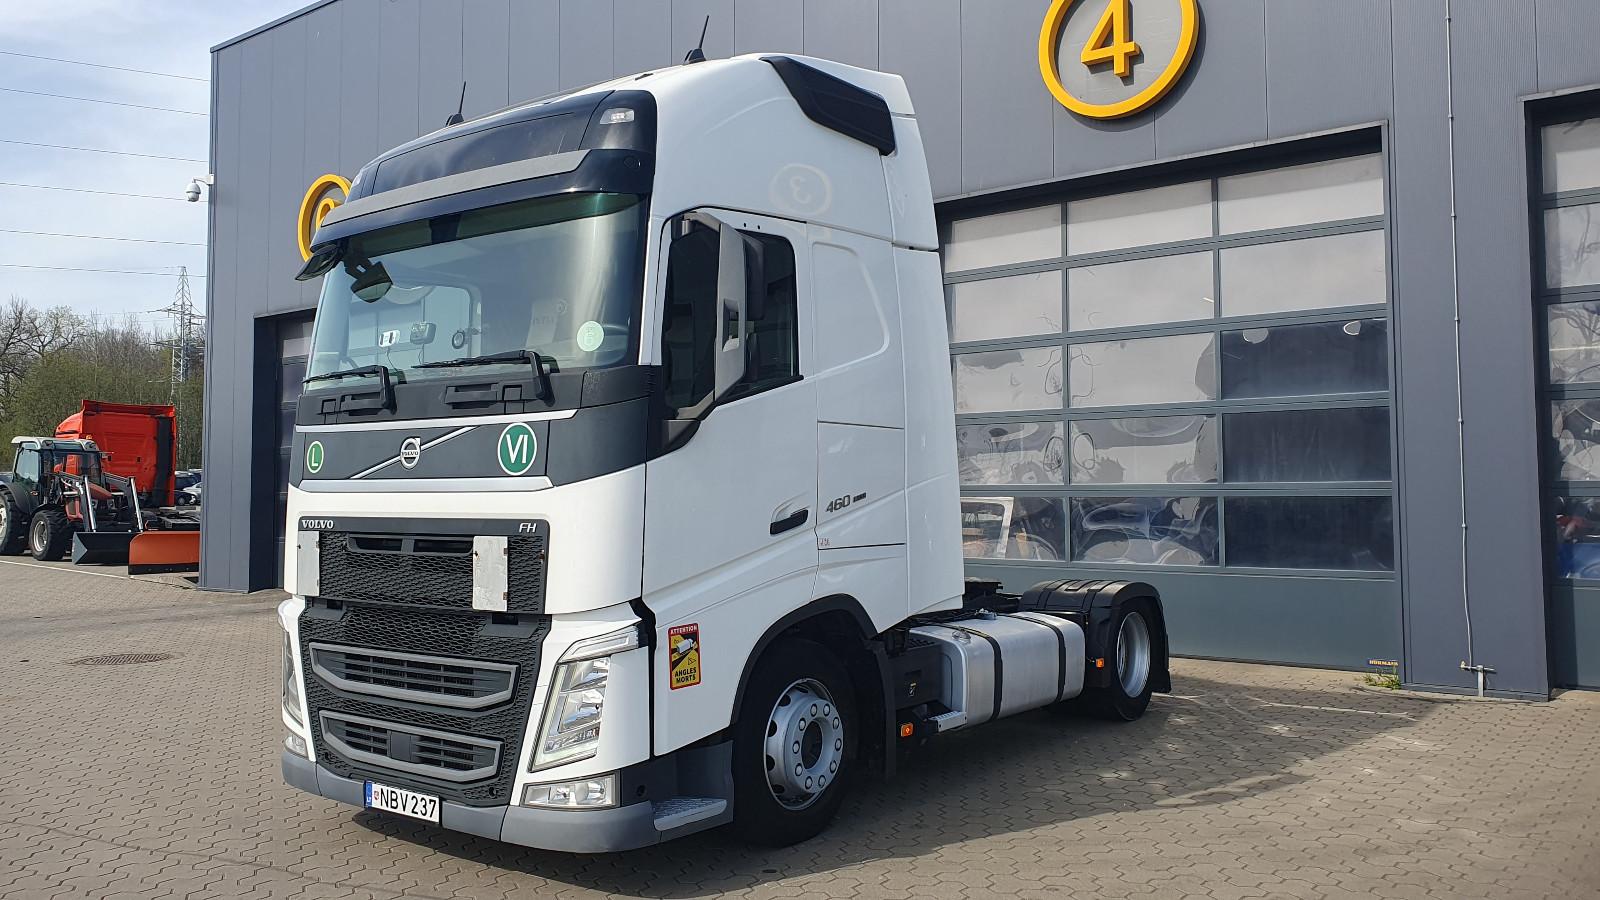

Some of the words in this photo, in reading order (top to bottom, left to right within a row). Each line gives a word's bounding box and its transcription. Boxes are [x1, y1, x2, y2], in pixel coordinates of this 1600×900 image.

[1080, 0, 1140, 77] 4
[506, 434, 529, 464] VI
[311, 447, 319, 467] L
[825, 494, 851, 513] 460
[301, 519, 334, 529] VOLVO
[519, 522, 537, 533] FH
[671, 625, 697, 635] ATTENTION
[675, 667, 697, 677] ANGLES
[676, 674, 696, 683] MORTS
